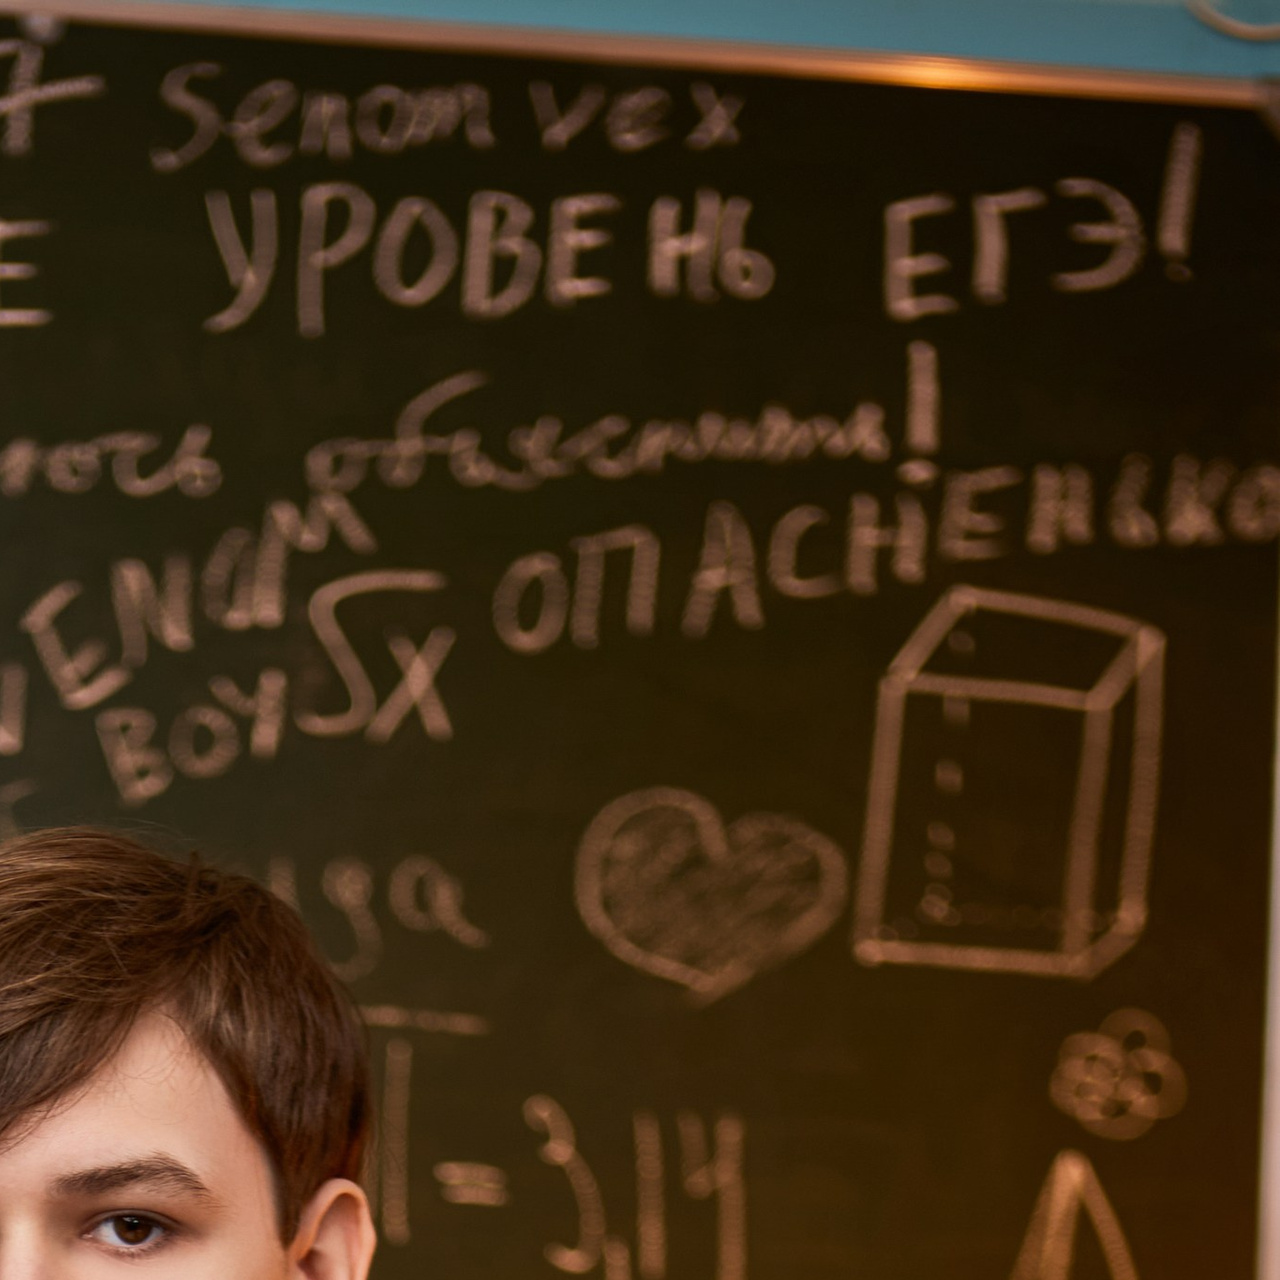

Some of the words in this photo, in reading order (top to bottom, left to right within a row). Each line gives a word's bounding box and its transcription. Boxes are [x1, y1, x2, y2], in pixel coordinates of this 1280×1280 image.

[204, 183, 776, 336] УРОВЕНЬ
[883, 122, 1204, 322] ЕГЭ!
[94, 664, 288, 808] BOY
